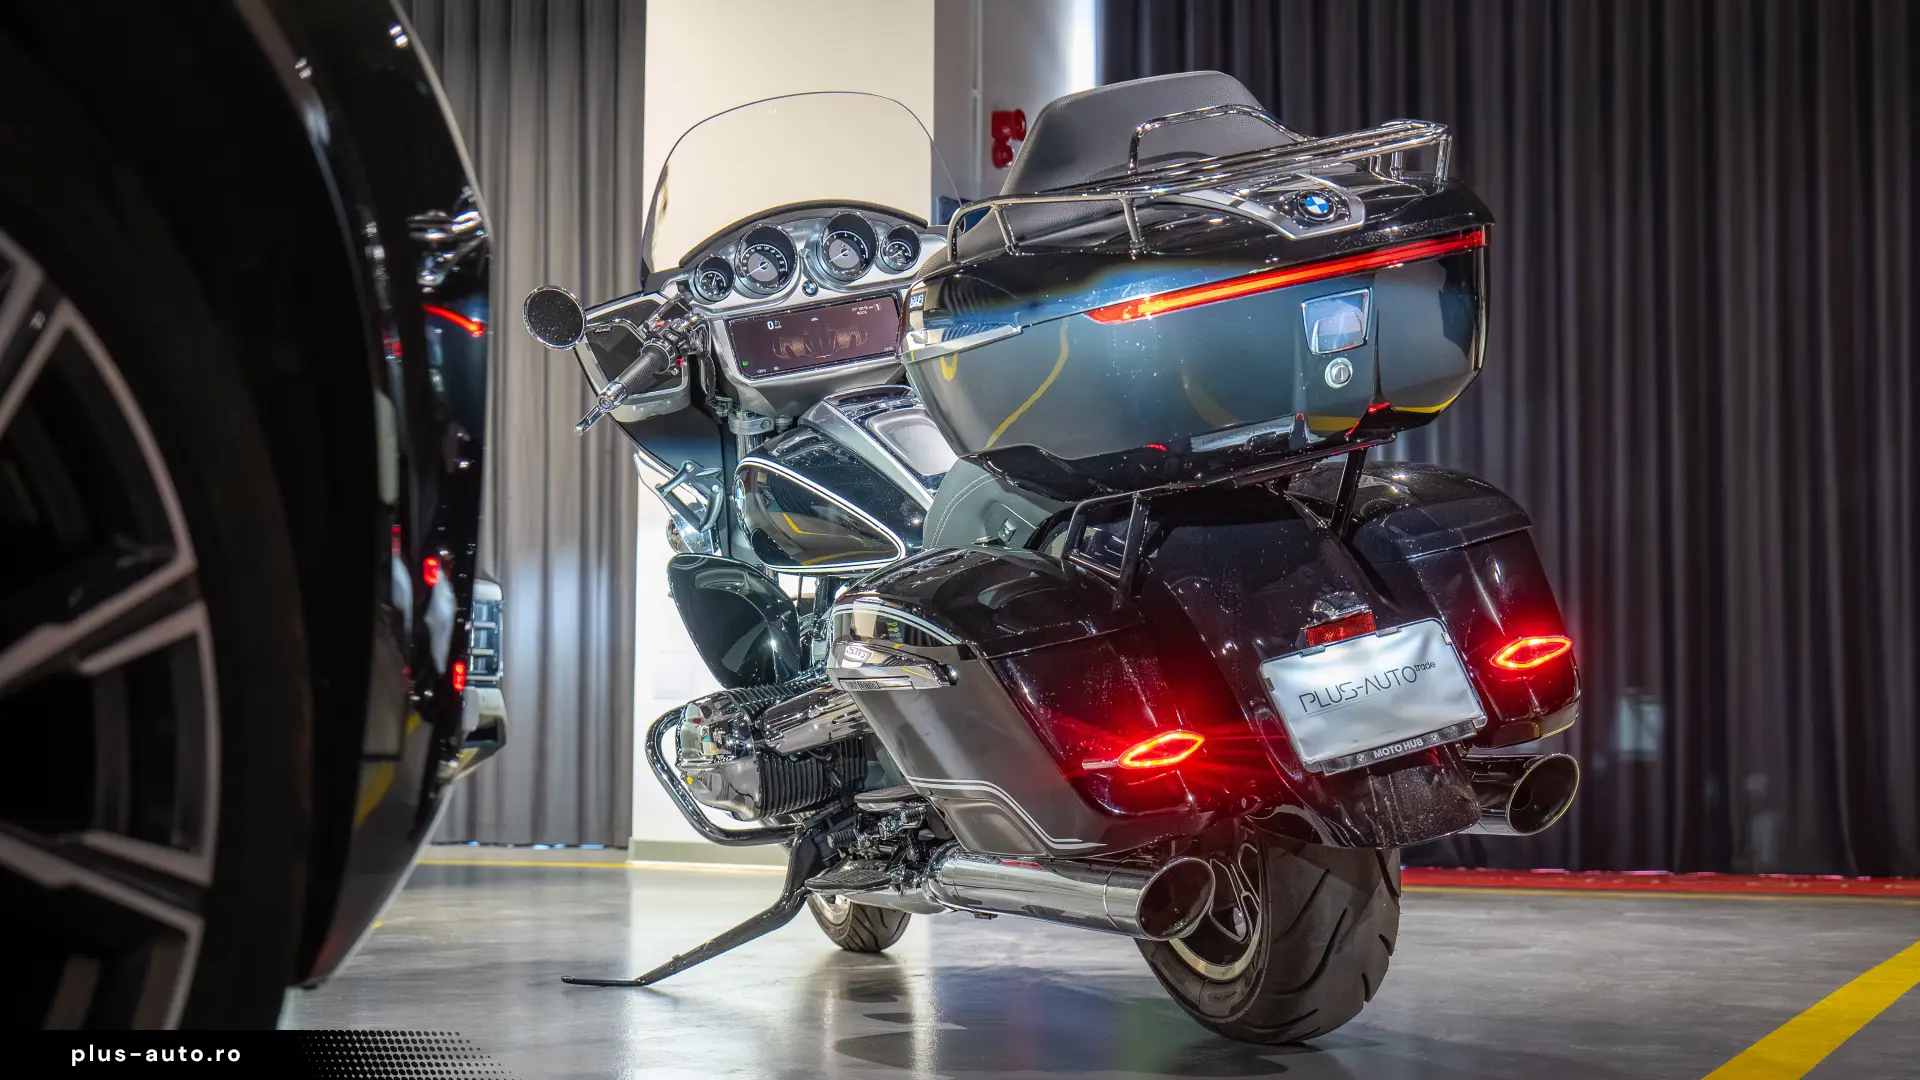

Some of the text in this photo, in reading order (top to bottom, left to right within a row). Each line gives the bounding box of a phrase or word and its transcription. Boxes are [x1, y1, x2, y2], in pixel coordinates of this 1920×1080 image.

[766, 320, 774, 330] 0
[1372, 738, 1424, 759] MOTO HUB
